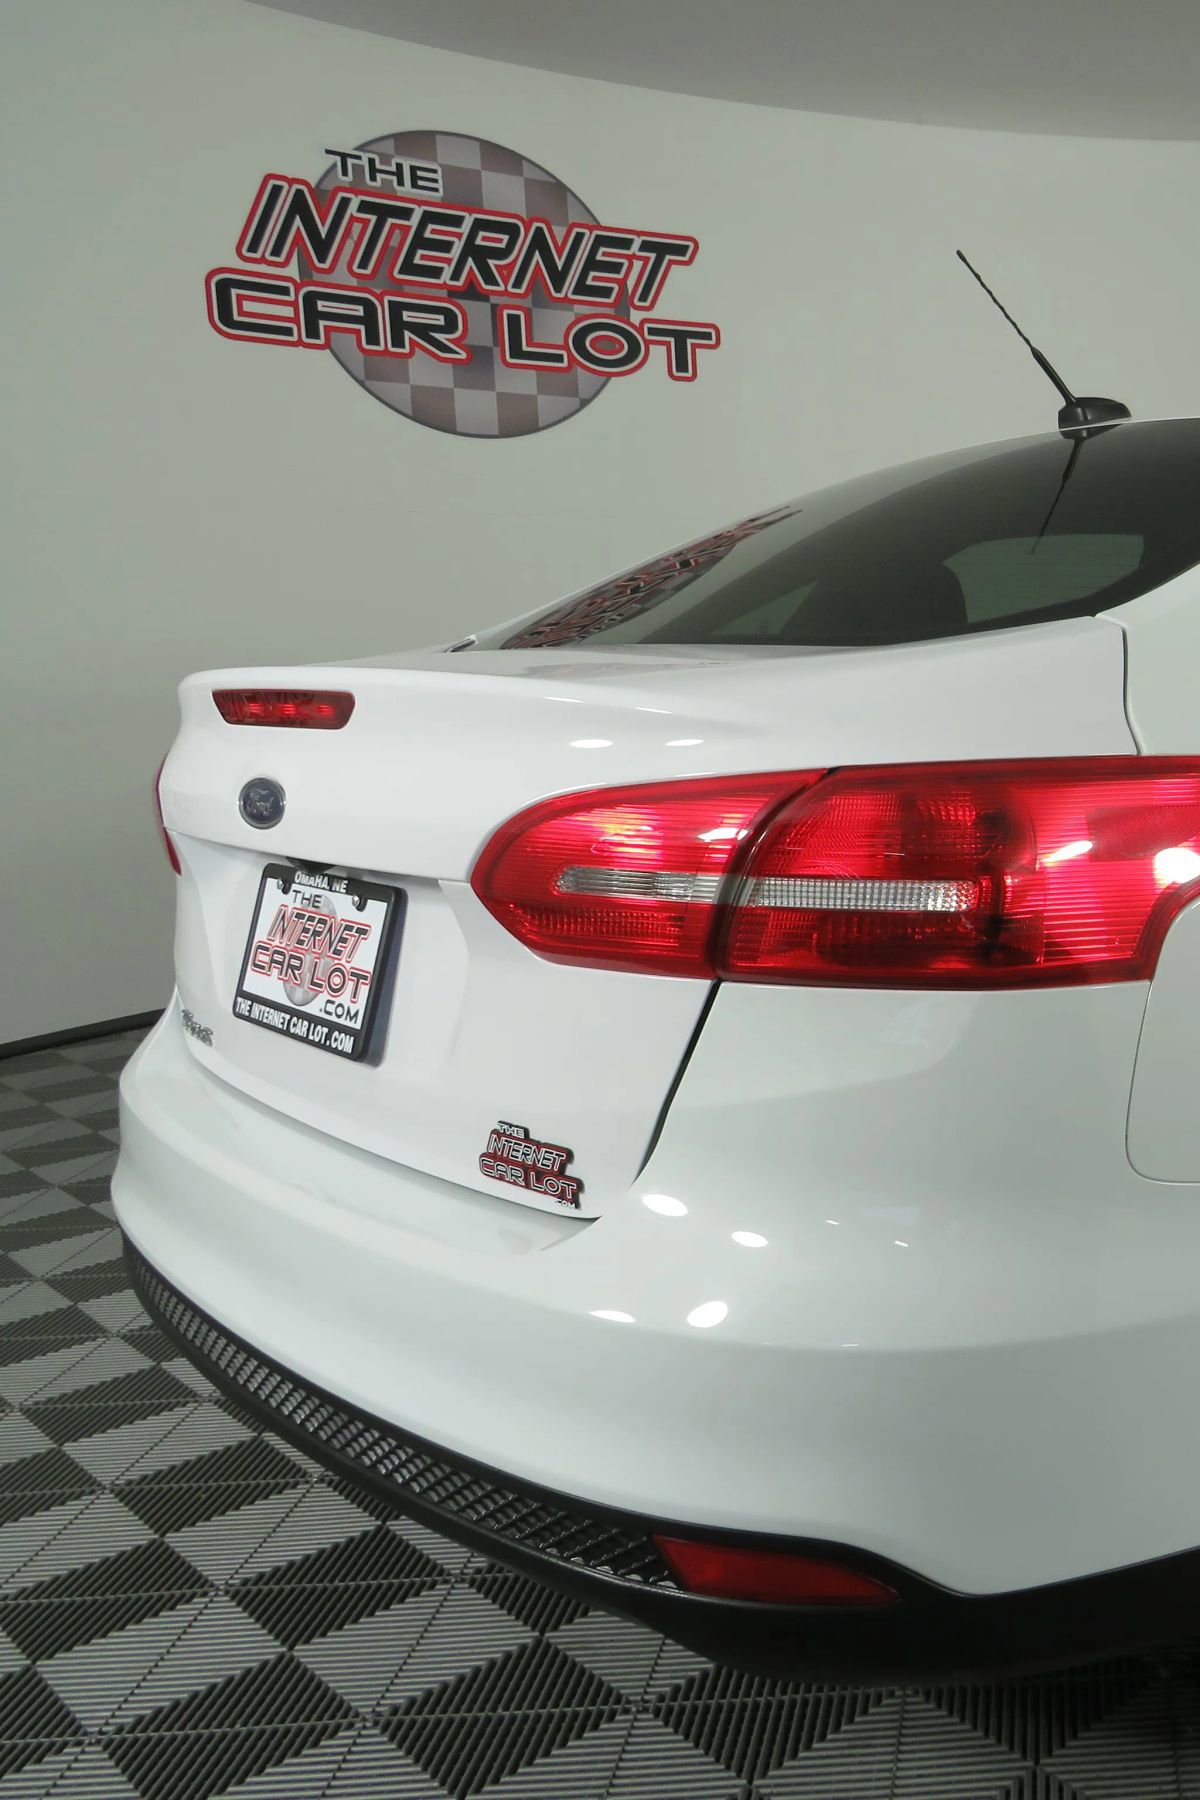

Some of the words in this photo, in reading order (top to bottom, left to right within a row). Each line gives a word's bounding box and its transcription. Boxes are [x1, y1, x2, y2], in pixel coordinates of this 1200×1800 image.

[323, 147, 443, 195] THE
[238, 175, 698, 309] INTERNET
[206, 270, 470, 362] CAR
[503, 306, 719, 380] LOT
[292, 890, 323, 909] THE
[331, 879, 349, 893] NE
[267, 904, 371, 963] INTERNET
[251, 942, 305, 985] CAR
[308, 958, 372, 1003] LOT
[236, 996, 252, 1016] THE
[250, 1002, 291, 1030] INTERNET
[290, 1016, 309, 1038] CAR
[319, 999, 360, 1024] .COM
[497, 1122, 525, 1139] THE
[487, 1133, 567, 1171] INTERNET
[479, 1156, 526, 1187] CAR
[529, 1171, 577, 1199] LOT
